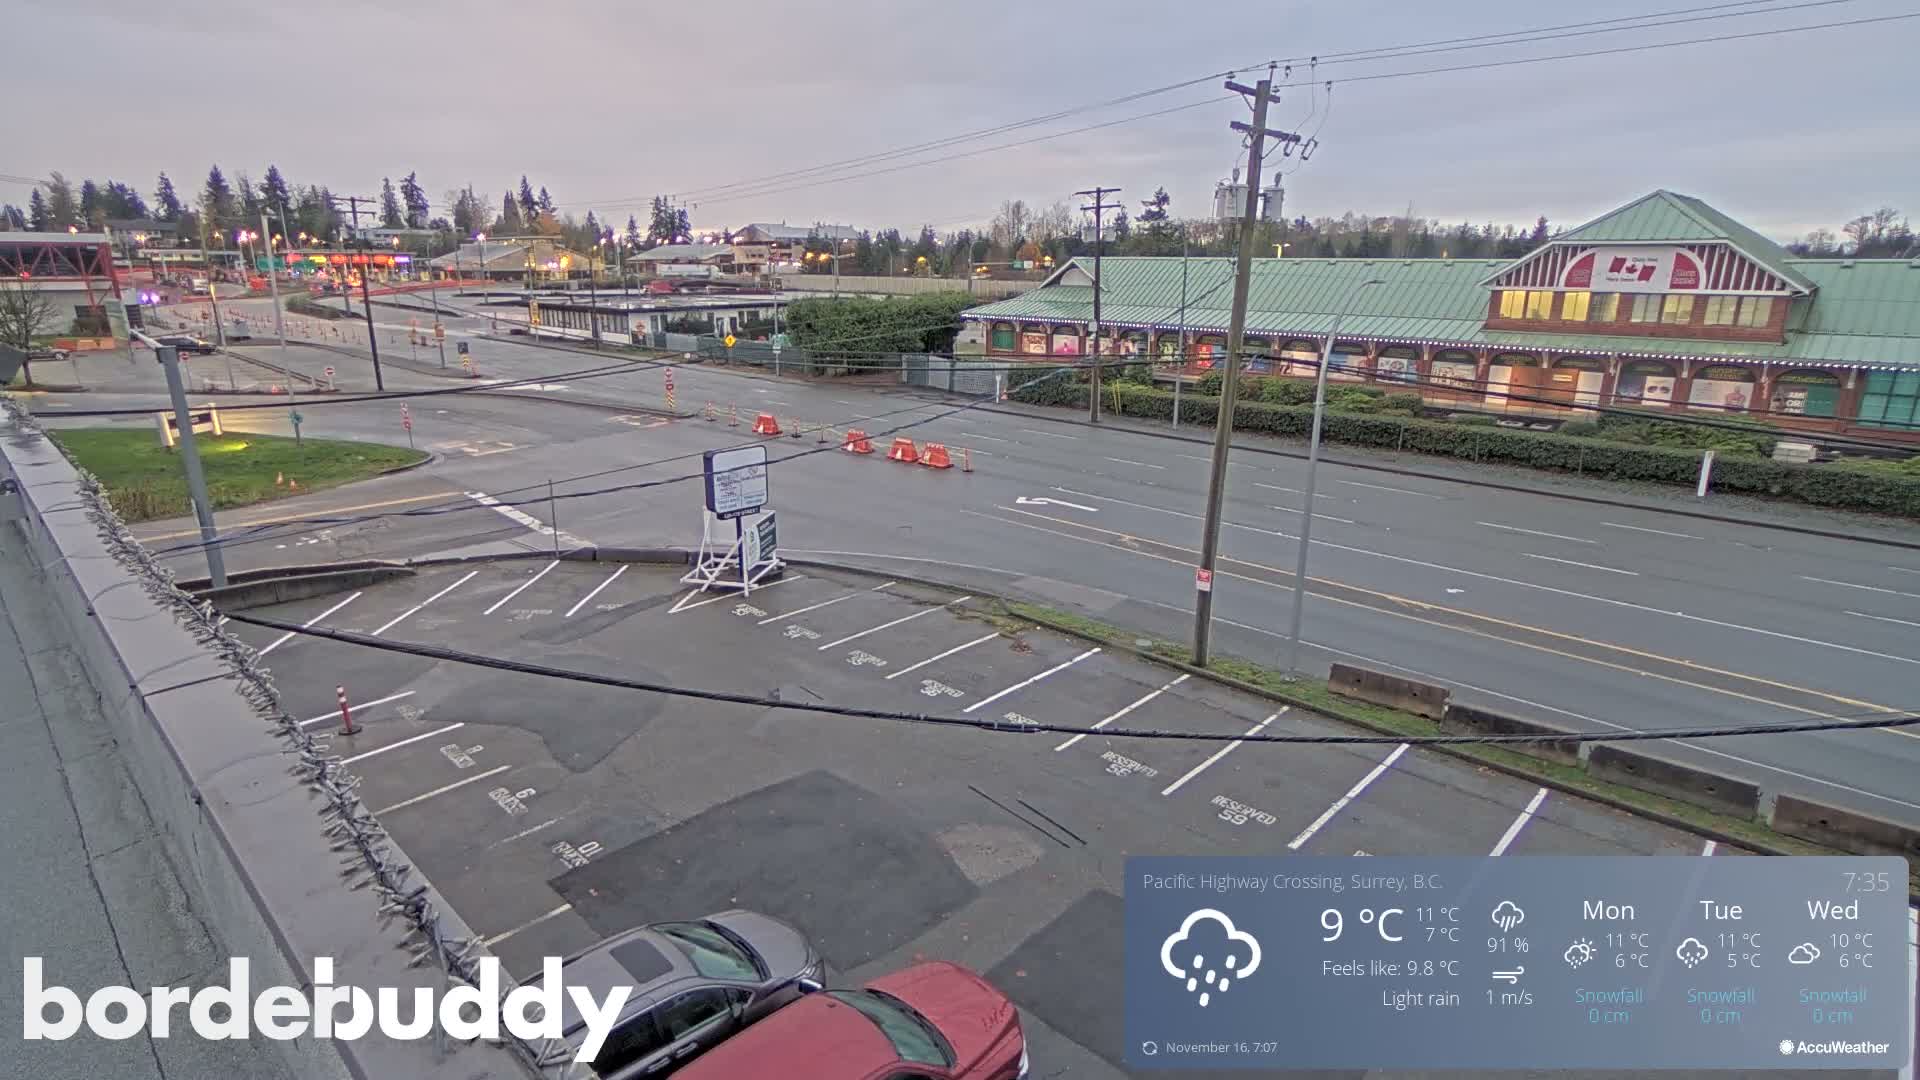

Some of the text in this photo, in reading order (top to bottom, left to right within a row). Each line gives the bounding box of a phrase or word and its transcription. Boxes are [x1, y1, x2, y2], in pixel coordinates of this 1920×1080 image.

[1101, 751, 1159, 777] RESERVED
[1210, 795, 1276, 825] RESERVED
[1217, 808, 1249, 825] 59
